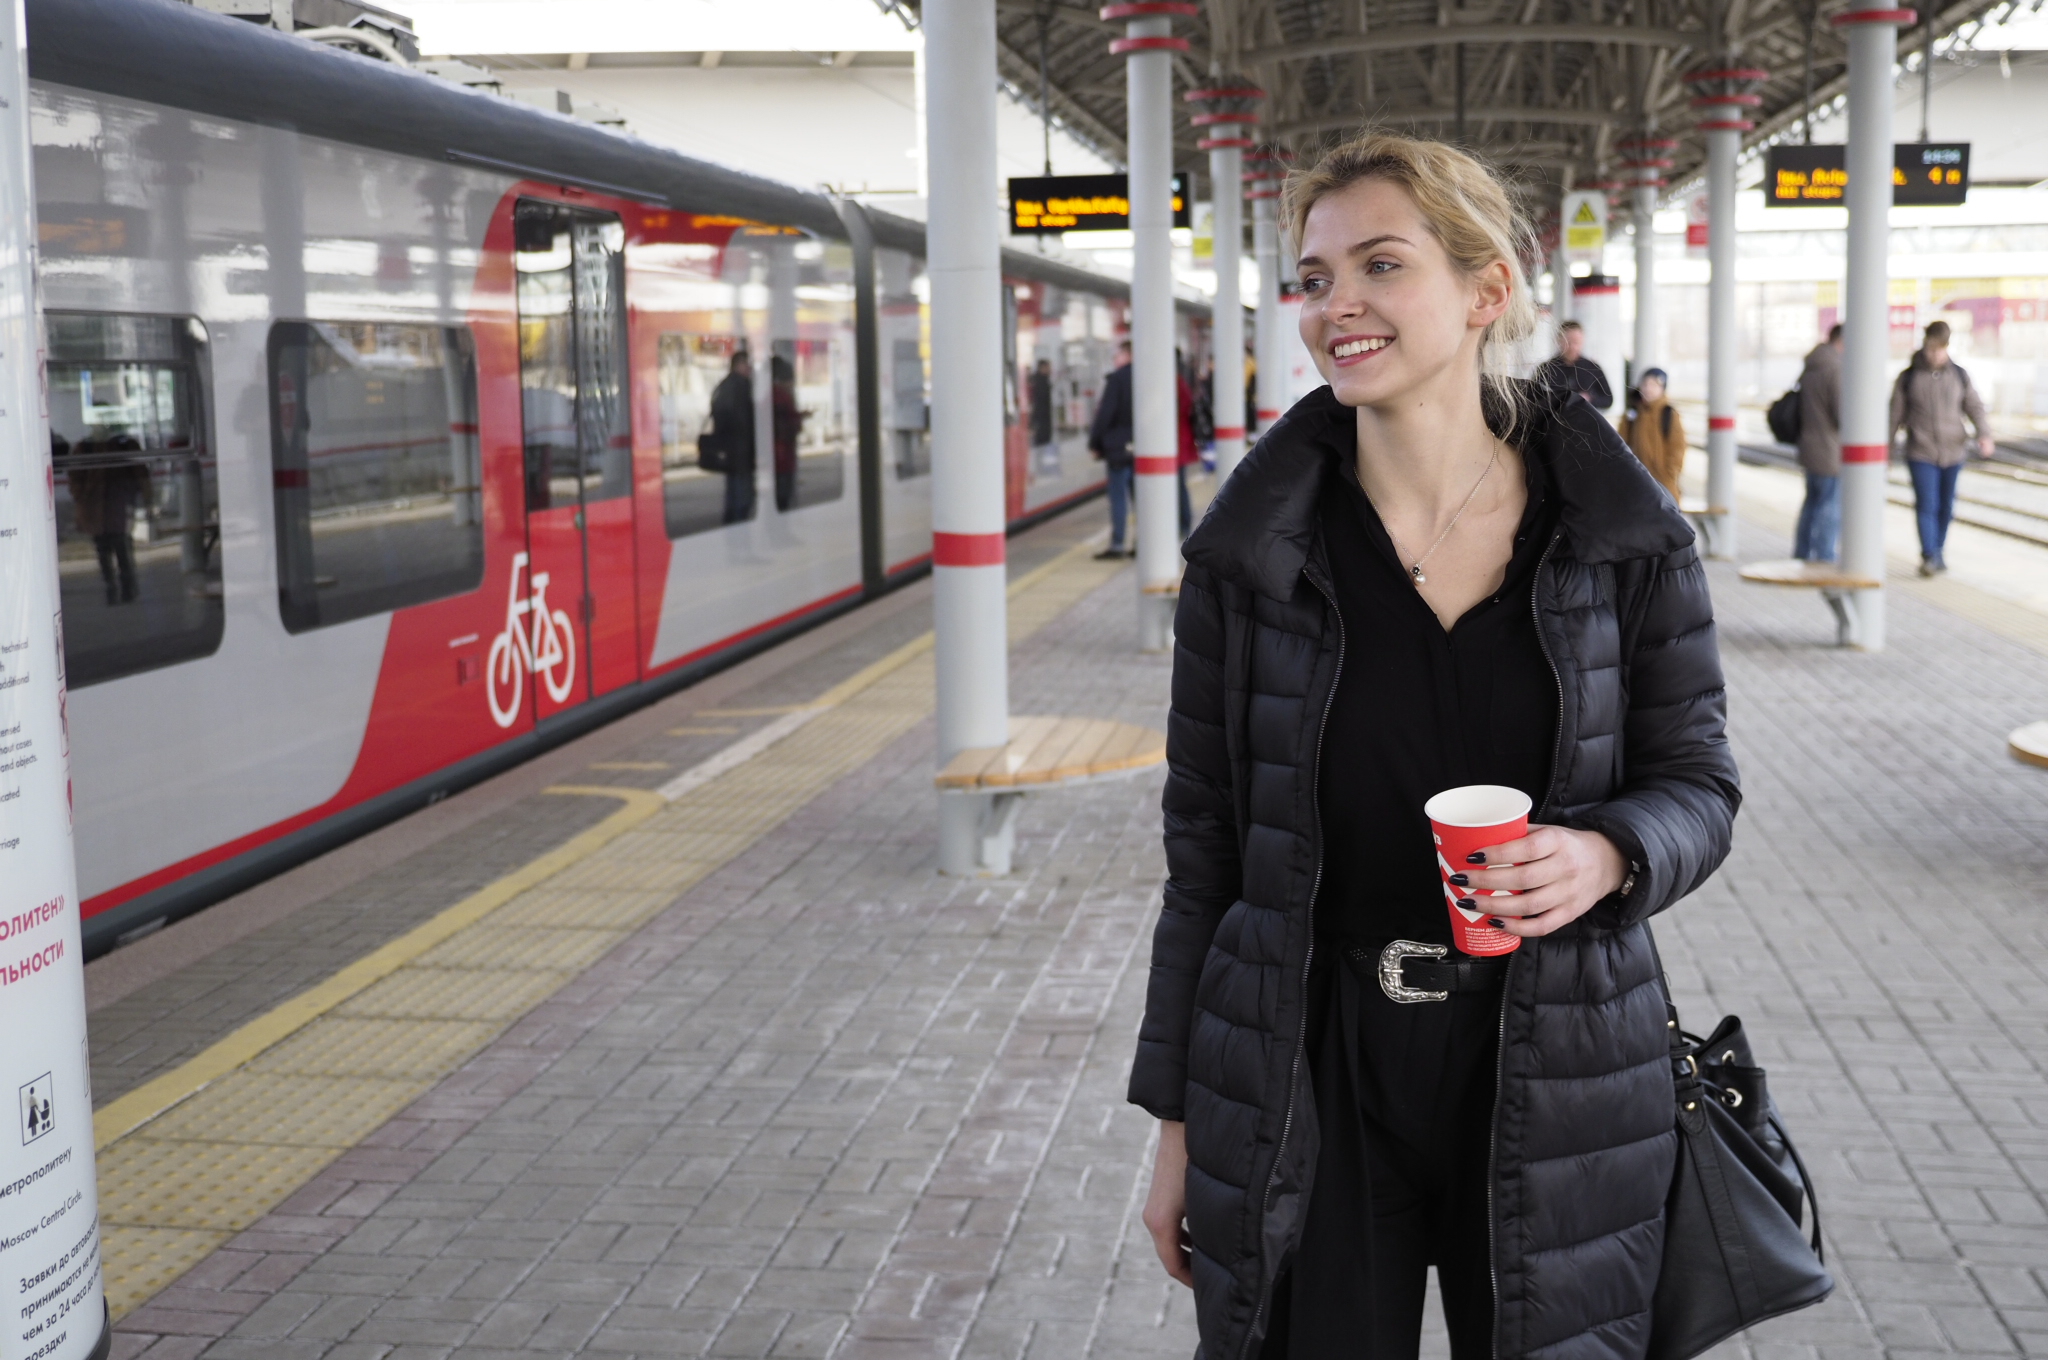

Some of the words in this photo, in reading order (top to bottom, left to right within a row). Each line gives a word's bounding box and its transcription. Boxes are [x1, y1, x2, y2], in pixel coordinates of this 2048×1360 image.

[2, 637, 28, 654] technical
[0, 721, 20, 737] ensed
[16, 739, 33, 751] cases
[0, 786, 20, 802] cated
[0, 939, 64, 986] льности
[0, 1224, 39, 1252] Moscow
[40, 1201, 67, 1229] Central
[19, 1263, 57, 1294] Заявки
[59, 1253, 69, 1271] до
[21, 1266, 82, 1319] принимаются
[83, 1257, 89, 1271] не
[22, 1323, 43, 1341] чем
[45, 1313, 57, 1329] за
[59, 1298, 70, 1319] 24
[71, 1285, 87, 1306] часа
[24, 1331, 67, 1360] поездки
